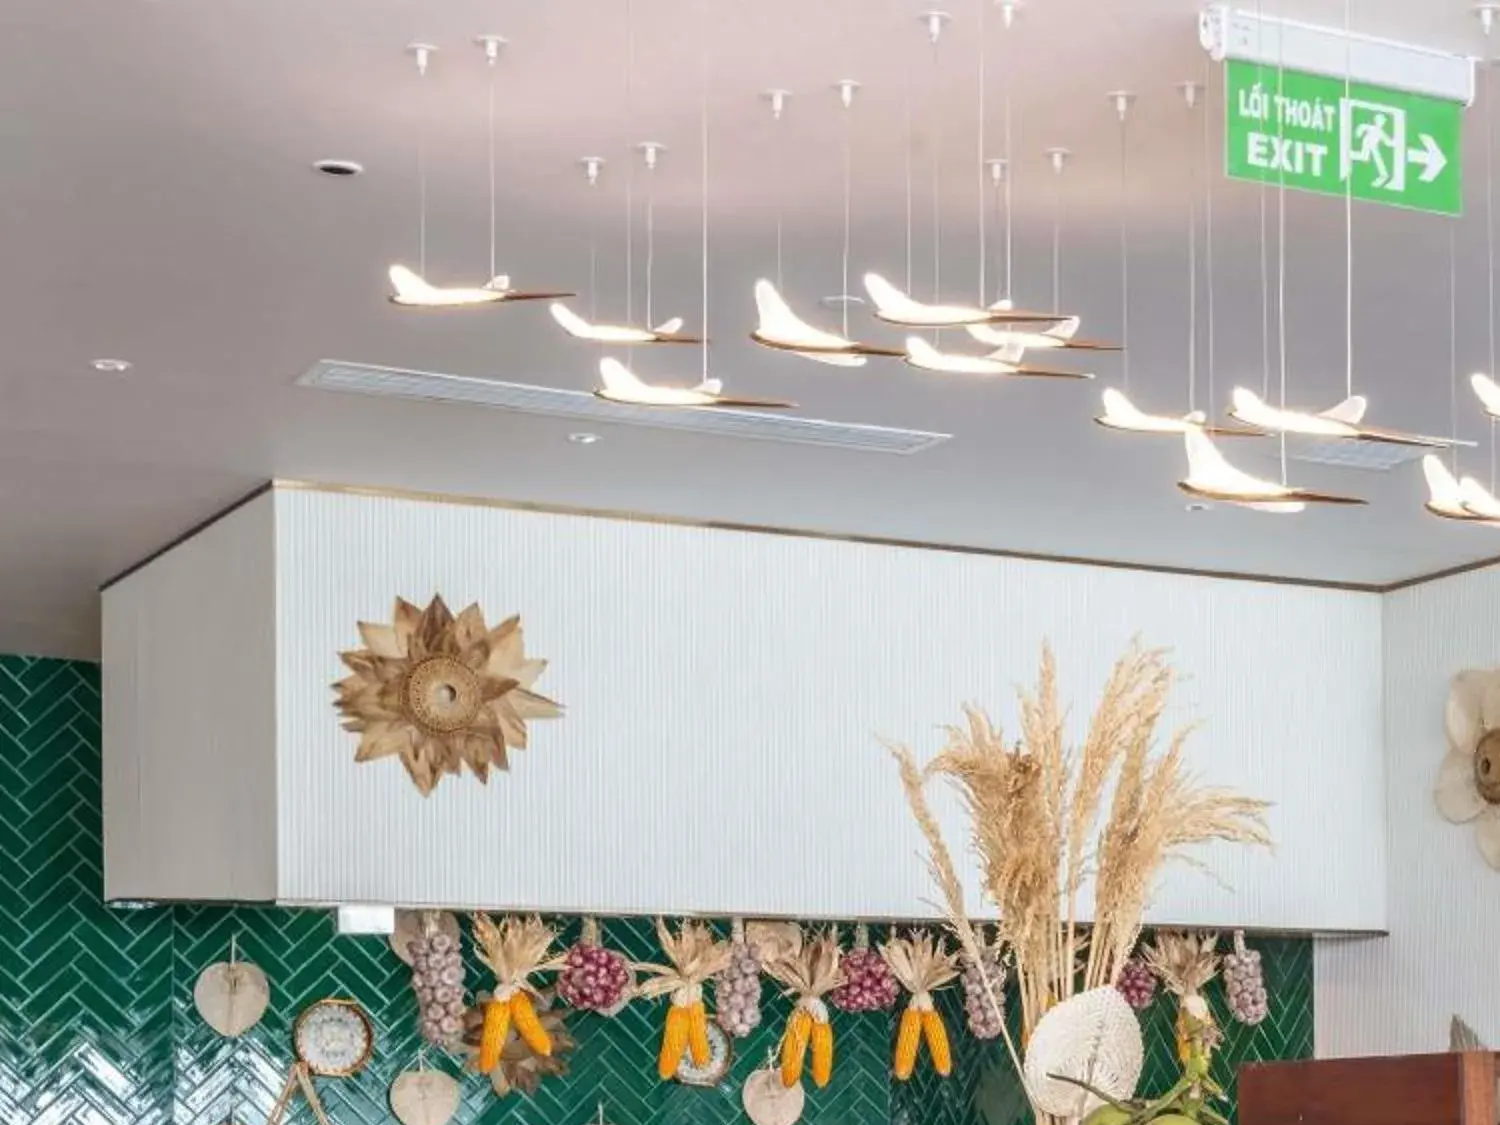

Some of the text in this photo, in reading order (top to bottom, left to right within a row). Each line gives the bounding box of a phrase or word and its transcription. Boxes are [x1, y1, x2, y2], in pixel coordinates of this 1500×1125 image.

[1239, 82, 1336, 132] LỐI THOÁT
[1247, 131, 1328, 177] EXIT
